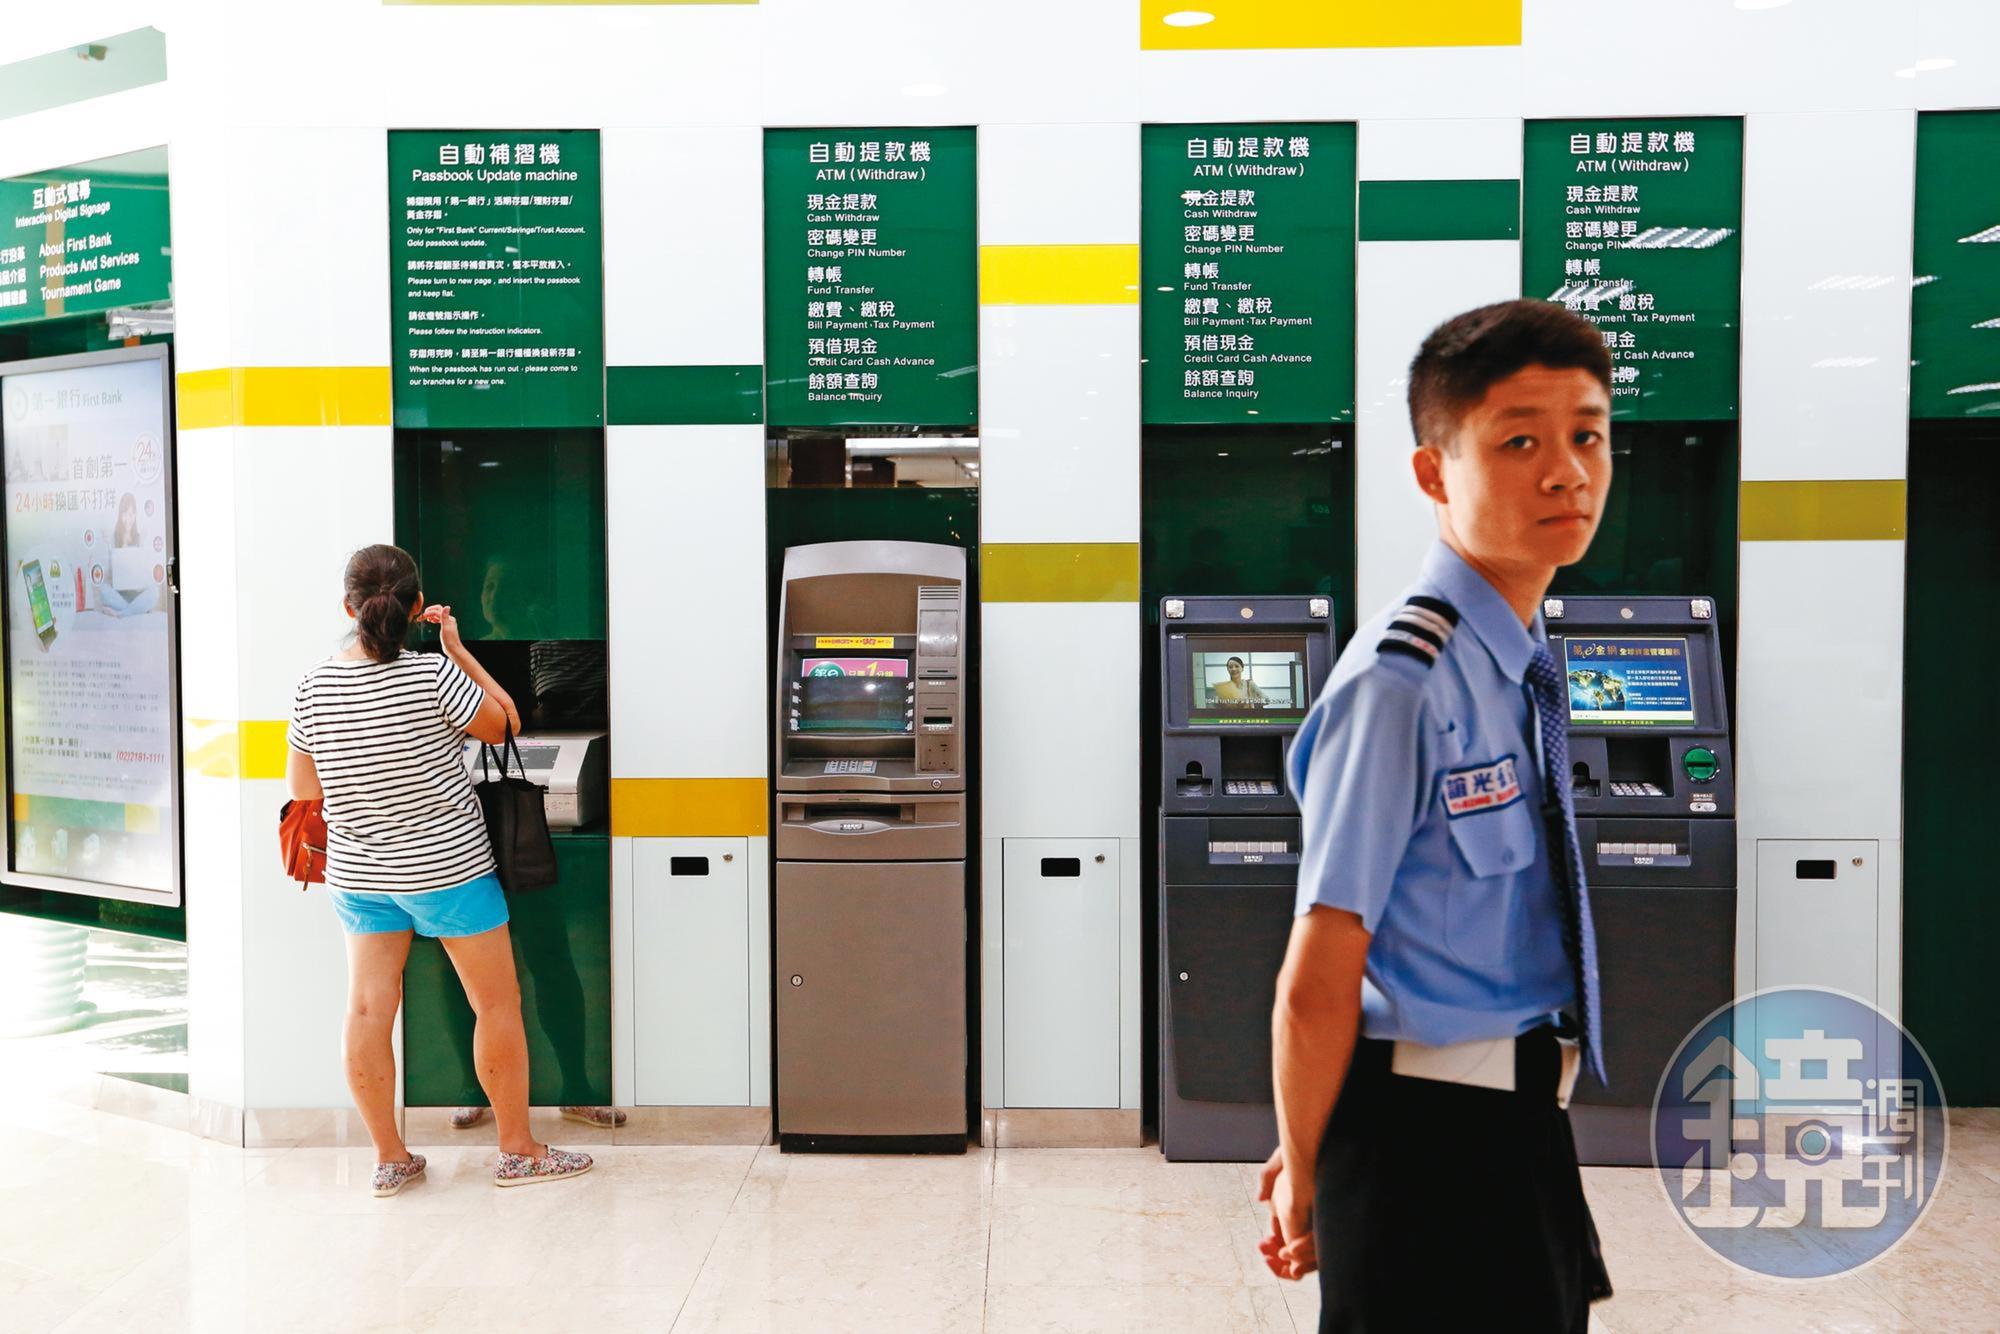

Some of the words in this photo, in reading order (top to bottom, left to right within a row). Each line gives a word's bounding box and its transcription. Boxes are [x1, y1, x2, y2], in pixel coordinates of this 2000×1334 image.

[1188, 137, 1309, 158] 自動提款機
[1571, 131, 1694, 154] 自動提款機
[440, 144, 560, 164] 自動補摺機
[810, 141, 930, 162] 自動提款機
[1194, 165, 1223, 176] ATM
[1576, 160, 1606, 172] ATM
[413, 170, 473, 181] Passbook
[477, 170, 521, 183] Update
[526, 170, 577, 180] machine
[816, 169, 845, 180] ATM
[808, 193, 876, 210] 現金提款
[1184, 190, 1254, 206] 現金提款
[1567, 185, 1638, 202] 現金提款
[15, 211, 52, 228] Interactive
[54, 206, 78, 222] Digital
[80, 202, 111, 216] Signage
[807, 214, 831, 222] Cash
[1184, 210, 1209, 218] Cash
[1566, 206, 1591, 214] Cash
[407, 227, 424, 235] Only
[808, 229, 876, 245] 密碼變更
[1185, 225, 1254, 241] 密碼變更
[1566, 221, 1637, 238] 密碼變更
[39, 243, 64, 258] About
[66, 237, 87, 252] First
[89, 232, 112, 247] Bank
[1184, 245, 1221, 255] Change
[1566, 241, 1603, 251] Change
[1607, 241, 1624, 249] PIN
[808, 249, 844, 259] Change
[40, 263, 78, 279] Products
[80, 257, 97, 270] And
[100, 251, 140, 266] Services
[1185, 263, 1218, 279] 轉帳
[1565, 259, 1600, 276] 轉帳
[808, 266, 842, 283] 轉帳
[40, 284, 91, 301] Tournament
[94, 277, 121, 293] Game
[808, 286, 831, 294] Fund
[835, 286, 874, 294] Transfer
[1184, 282, 1207, 290] Fund
[1212, 282, 1251, 290] Transfer
[1565, 278, 1590, 288] Fund
[1593, 278, 1633, 288] Transfer
[808, 301, 895, 317] 繳費、繳稅
[1185, 298, 1272, 314] 繳費、繳稅
[808, 321, 822, 329] Bill
[893, 320, 934, 330] Payment
[1270, 317, 1312, 326] Payment
[1632, 314, 1648, 322] Tax
[1652, 313, 1694, 323] Payment
[808, 338, 877, 354] 預借現金
[1184, 335, 1253, 351] 預借現金
[1601, 331, 1636, 348] 現金
[808, 357, 836, 366] Credit
[1243, 354, 1267, 362] Cash
[1270, 354, 1311, 362] Advance
[1624, 351, 1648, 359] Cash
[1652, 351, 1694, 359] Advance
[809, 373, 877, 389] 餘額查詢
[1185, 370, 1253, 386] 餘額查詢
[101, 389, 122, 405] Bank
[848, 393, 882, 402] Inquiry
[1226, 390, 1258, 399] Inquiry
[1611, 386, 1640, 397] nquiry
